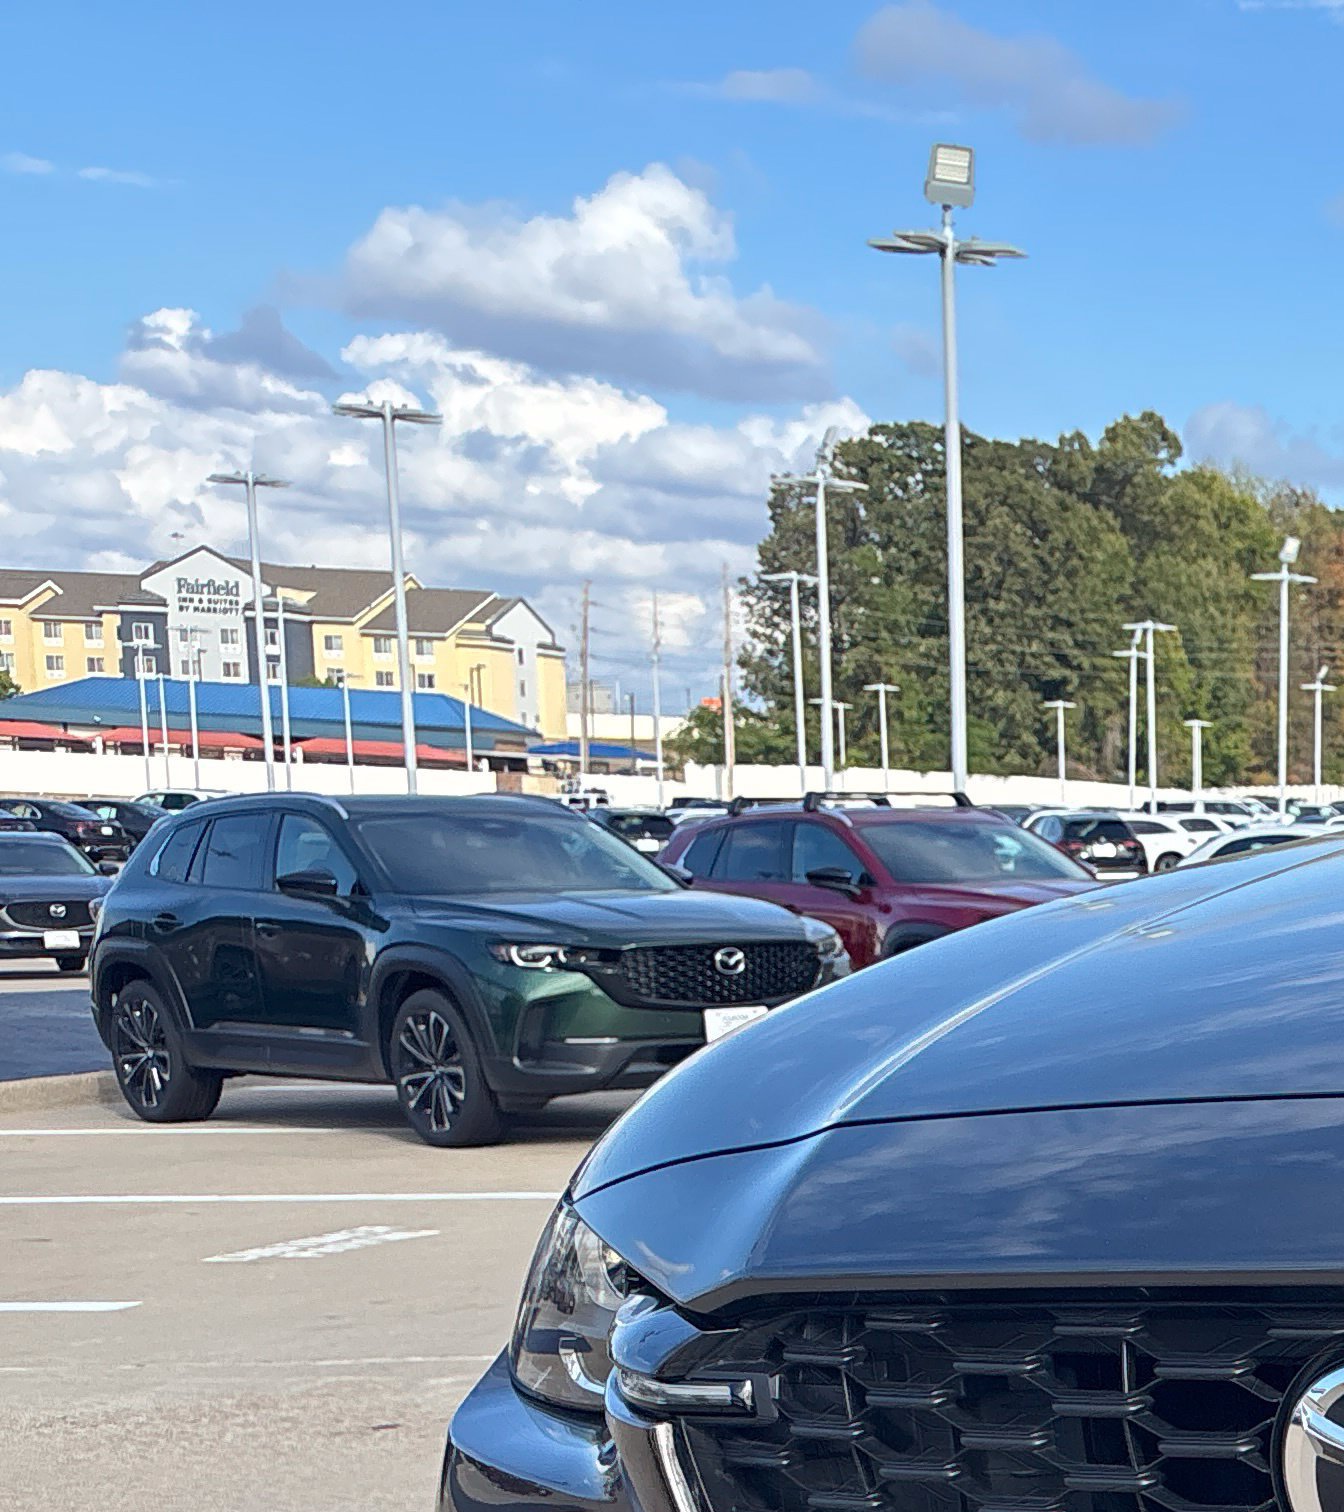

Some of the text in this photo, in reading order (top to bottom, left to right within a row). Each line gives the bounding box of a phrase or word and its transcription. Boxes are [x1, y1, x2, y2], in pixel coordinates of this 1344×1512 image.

[176, 577, 240, 597] Fairfield
[179, 604, 240, 616] BY MARRIOTT
